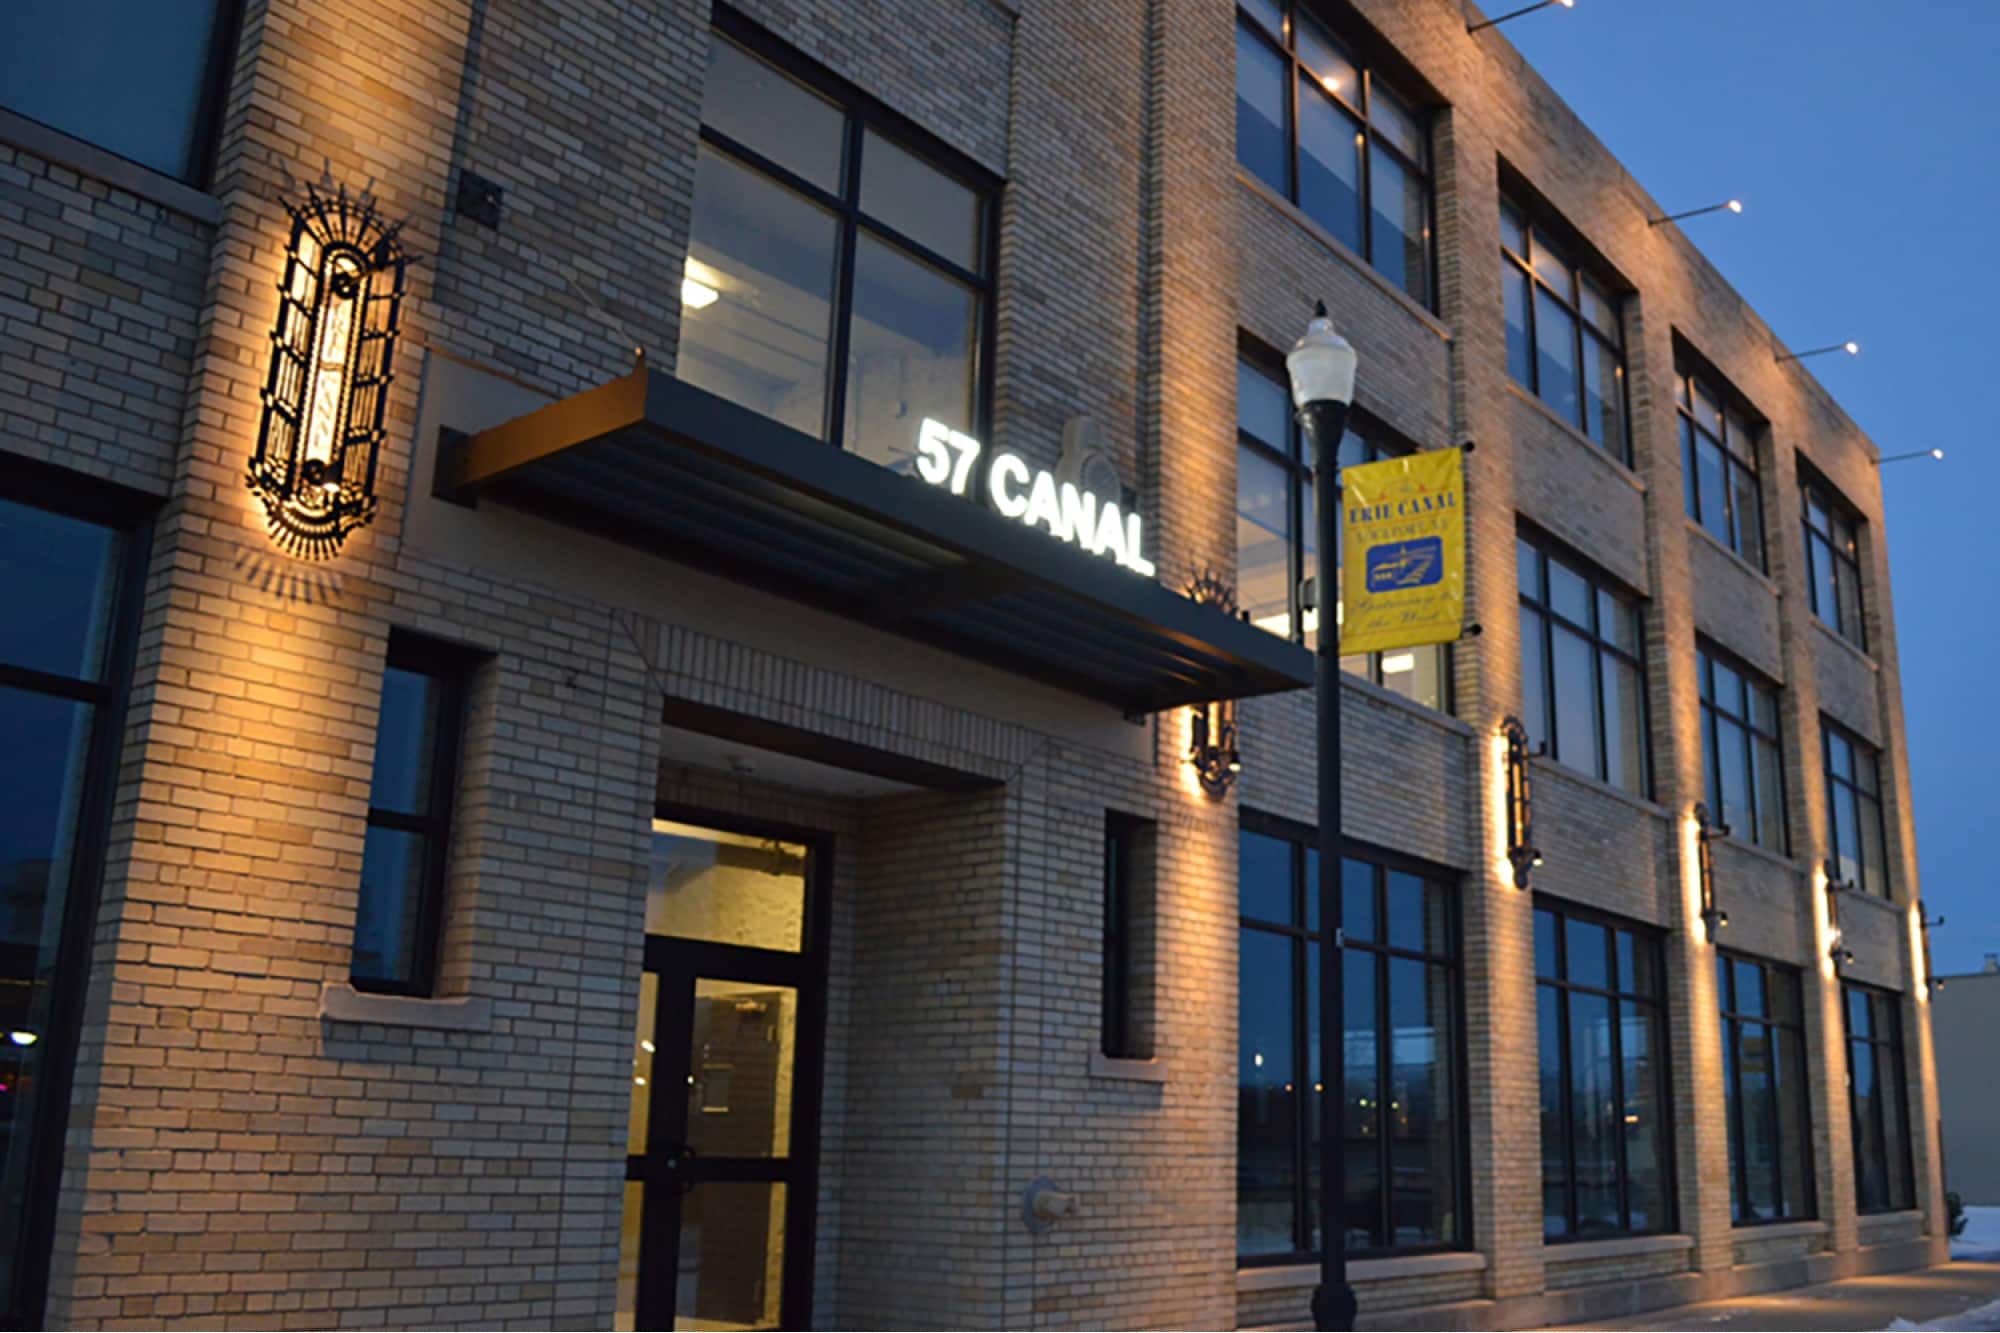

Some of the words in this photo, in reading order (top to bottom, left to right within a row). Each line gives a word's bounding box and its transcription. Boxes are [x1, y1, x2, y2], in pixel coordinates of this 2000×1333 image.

[916, 417, 981, 495] 57
[989, 453, 1155, 577] CANAL
[1350, 502, 1392, 524] ERIE
[1397, 491, 1456, 517] CANAL
